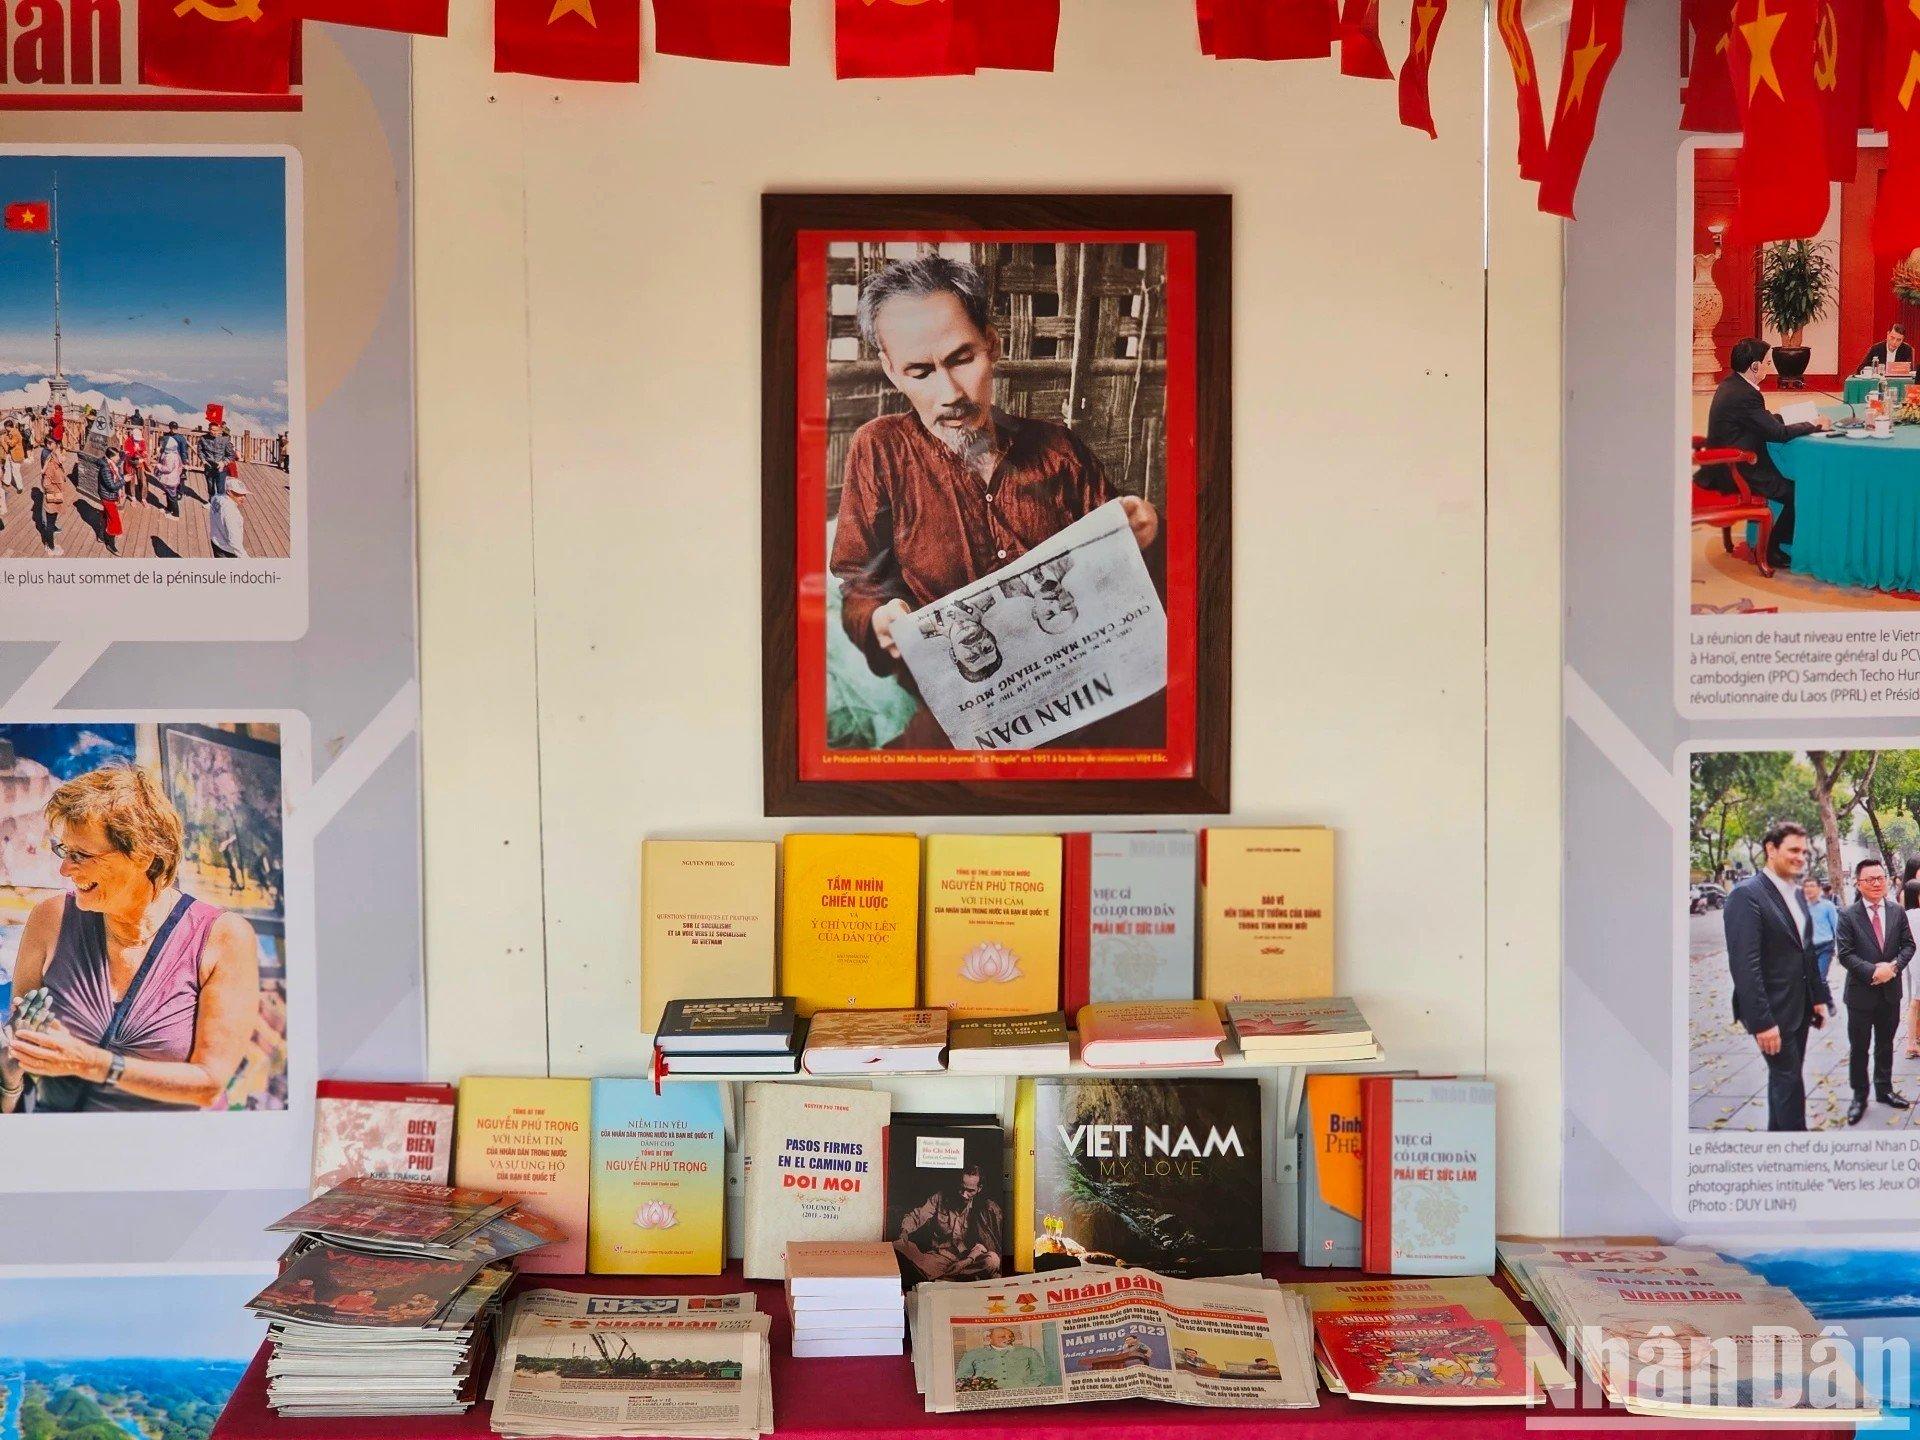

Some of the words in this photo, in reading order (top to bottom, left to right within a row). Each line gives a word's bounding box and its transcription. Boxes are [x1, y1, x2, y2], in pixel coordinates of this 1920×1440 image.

[4, 571, 15, 584] le
[19, 571, 43, 586] plus
[48, 571, 75, 584] haut
[79, 572, 130, 584] sommet
[134, 571, 149, 584] de
[153, 571, 162, 584] la
[166, 571, 226, 586] péninsule
[230, 571, 281, 584] indochi-
[1690, 633, 1703, 645] La
[1707, 633, 1752, 644] réunion
[1756, 632, 1770, 644] de
[1774, 631, 1800, 643] haut
[1805, 632, 1842, 643] niveau
[1847, 632, 1876, 642] entre
[1880, 630, 1890, 642] le
[1690, 653, 1697, 665] à
[1700, 652, 1737, 666] Hanoï,
[1741, 653, 1771, 663] entre
[1775, 650, 1831, 663] Secrétaire
[1835, 649, 1878, 665] général
[1883, 649, 1897, 661] du
[1690, 671, 1764, 686] cambodgien
[1769, 670, 1799, 685] (PPC)
[1803, 669, 1857, 682] Samdech
[1860, 669, 1894, 681] Techo
[1690, 691, 1778, 704] révolutionnaire
[1782, 690, 1797, 703] du
[1801, 689, 1827, 702] Laos
[1831, 688, 1867, 703] (PPRL)
[1871, 689, 1882, 701] et
[786, 1139, 820, 1152] PASOS
[824, 1142, 862, 1155] FIRMES
[1057, 1124, 1133, 1157] VIET
[1145, 1124, 1245, 1157] NAM
[1689, 1143, 1700, 1155] Le
[1705, 1142, 1763, 1154] Rédacteur
[1767, 1145, 1781, 1153] en
[1785, 1141, 1809, 1153] chef
[1813, 1142, 1828, 1153] du
[1831, 1140, 1871, 1155] journal
[1876, 1140, 1906, 1151] Nhan
[778, 1155, 791, 1167] EN
[795, 1157, 805, 1168] EL
[809, 1158, 852, 1172] CAMINO
[855, 1161, 868, 1172] DE
[1431, 1153, 1453, 1162] CHO
[1456, 1151, 1477, 1162] DÂN
[606, 1157, 647, 1171] NGUYỄN
[650, 1159, 669, 1171] PHÚ
[673, 1162, 707, 1173] TRỌNG
[1100, 1161, 1132, 1176] MY
[1144, 1161, 1201, 1176] LOVE
[1688, 1161, 1753, 1177] journalistes
[1757, 1160, 1830, 1173] vietnamiens,
[1834, 1160, 1887, 1171] Monsieur
[1892, 1159, 1904, 1171] Le
[784, 1174, 817, 1189] DOI
[823, 1178, 860, 1192] MOI
[1689, 1180, 1773, 1195] photographies
[1777, 1179, 1823, 1192] intitulée
[1859, 1178, 1874, 1190] les
[1878, 1178, 1904, 1191] Jeux
[1688, 1199, 1726, 1213] (Photo
[1736, 1199, 1761, 1211] DUY
[1764, 1198, 1796, 1212] LINH)
[1116, 1275, 1163, 1295] Dân
[1130, 1325, 1165, 1336] 2023
